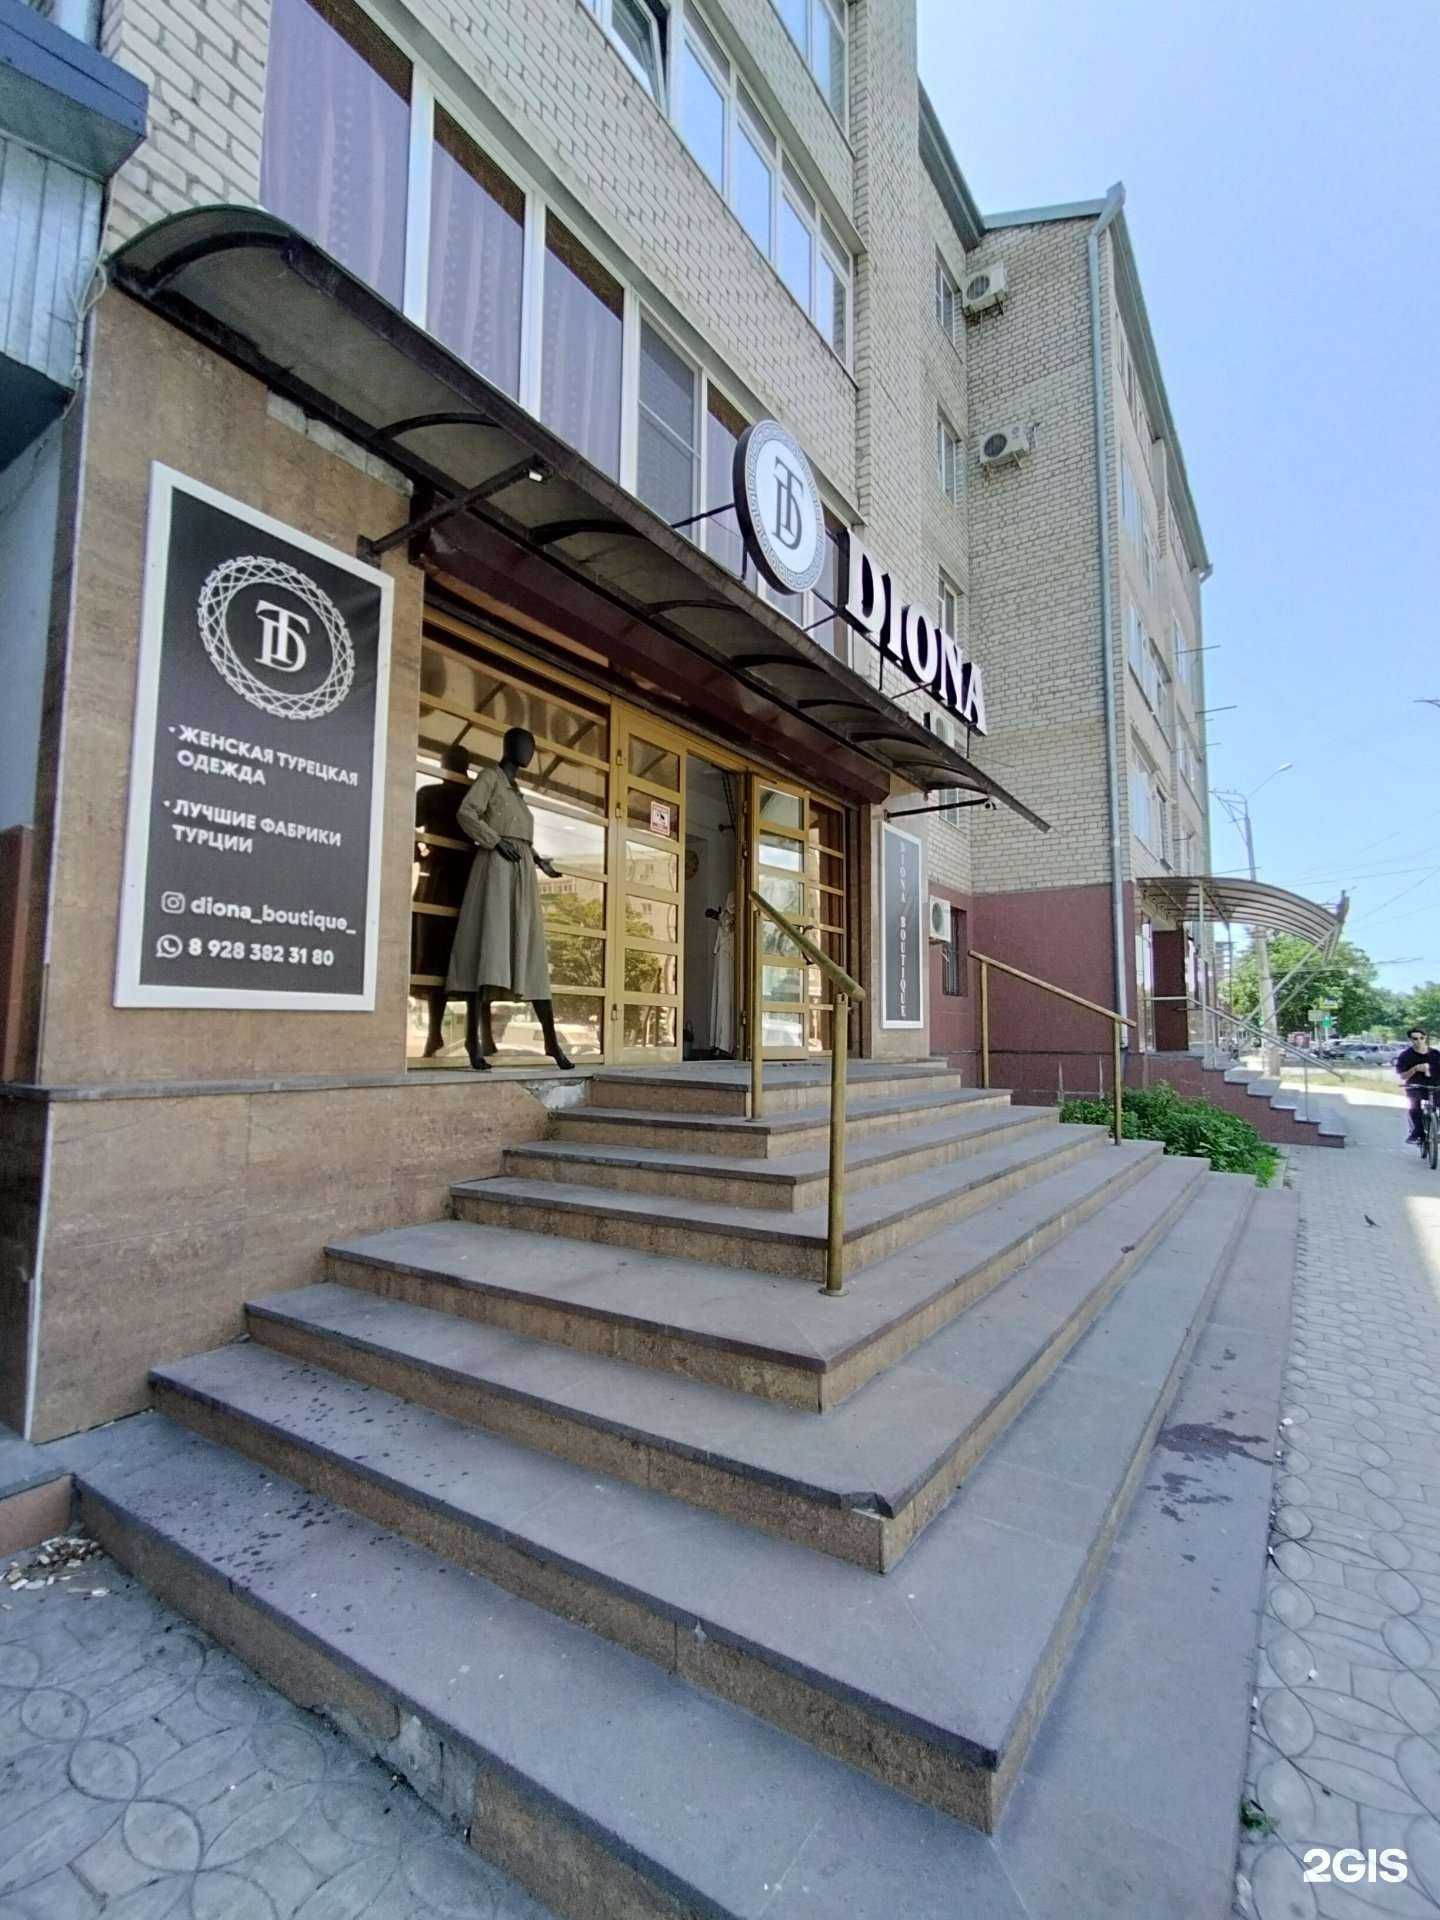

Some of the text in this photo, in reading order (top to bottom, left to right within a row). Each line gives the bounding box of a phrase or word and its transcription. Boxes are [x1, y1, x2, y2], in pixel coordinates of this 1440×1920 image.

[844, 527, 988, 737] DIONA
[176, 749, 267, 786] ОДЕЖДА
[177, 724, 359, 787] ЖЕНСКАЯ ТУРЕЦКАЯ
[171, 823, 254, 854] ТУРЦИИ
[172, 799, 342, 848] ЛУЧШИЕ ФАБРИКИ
[190, 896, 357, 935] diona_boutique_
[188, 938, 335, 967] 8 928 382 31 80
